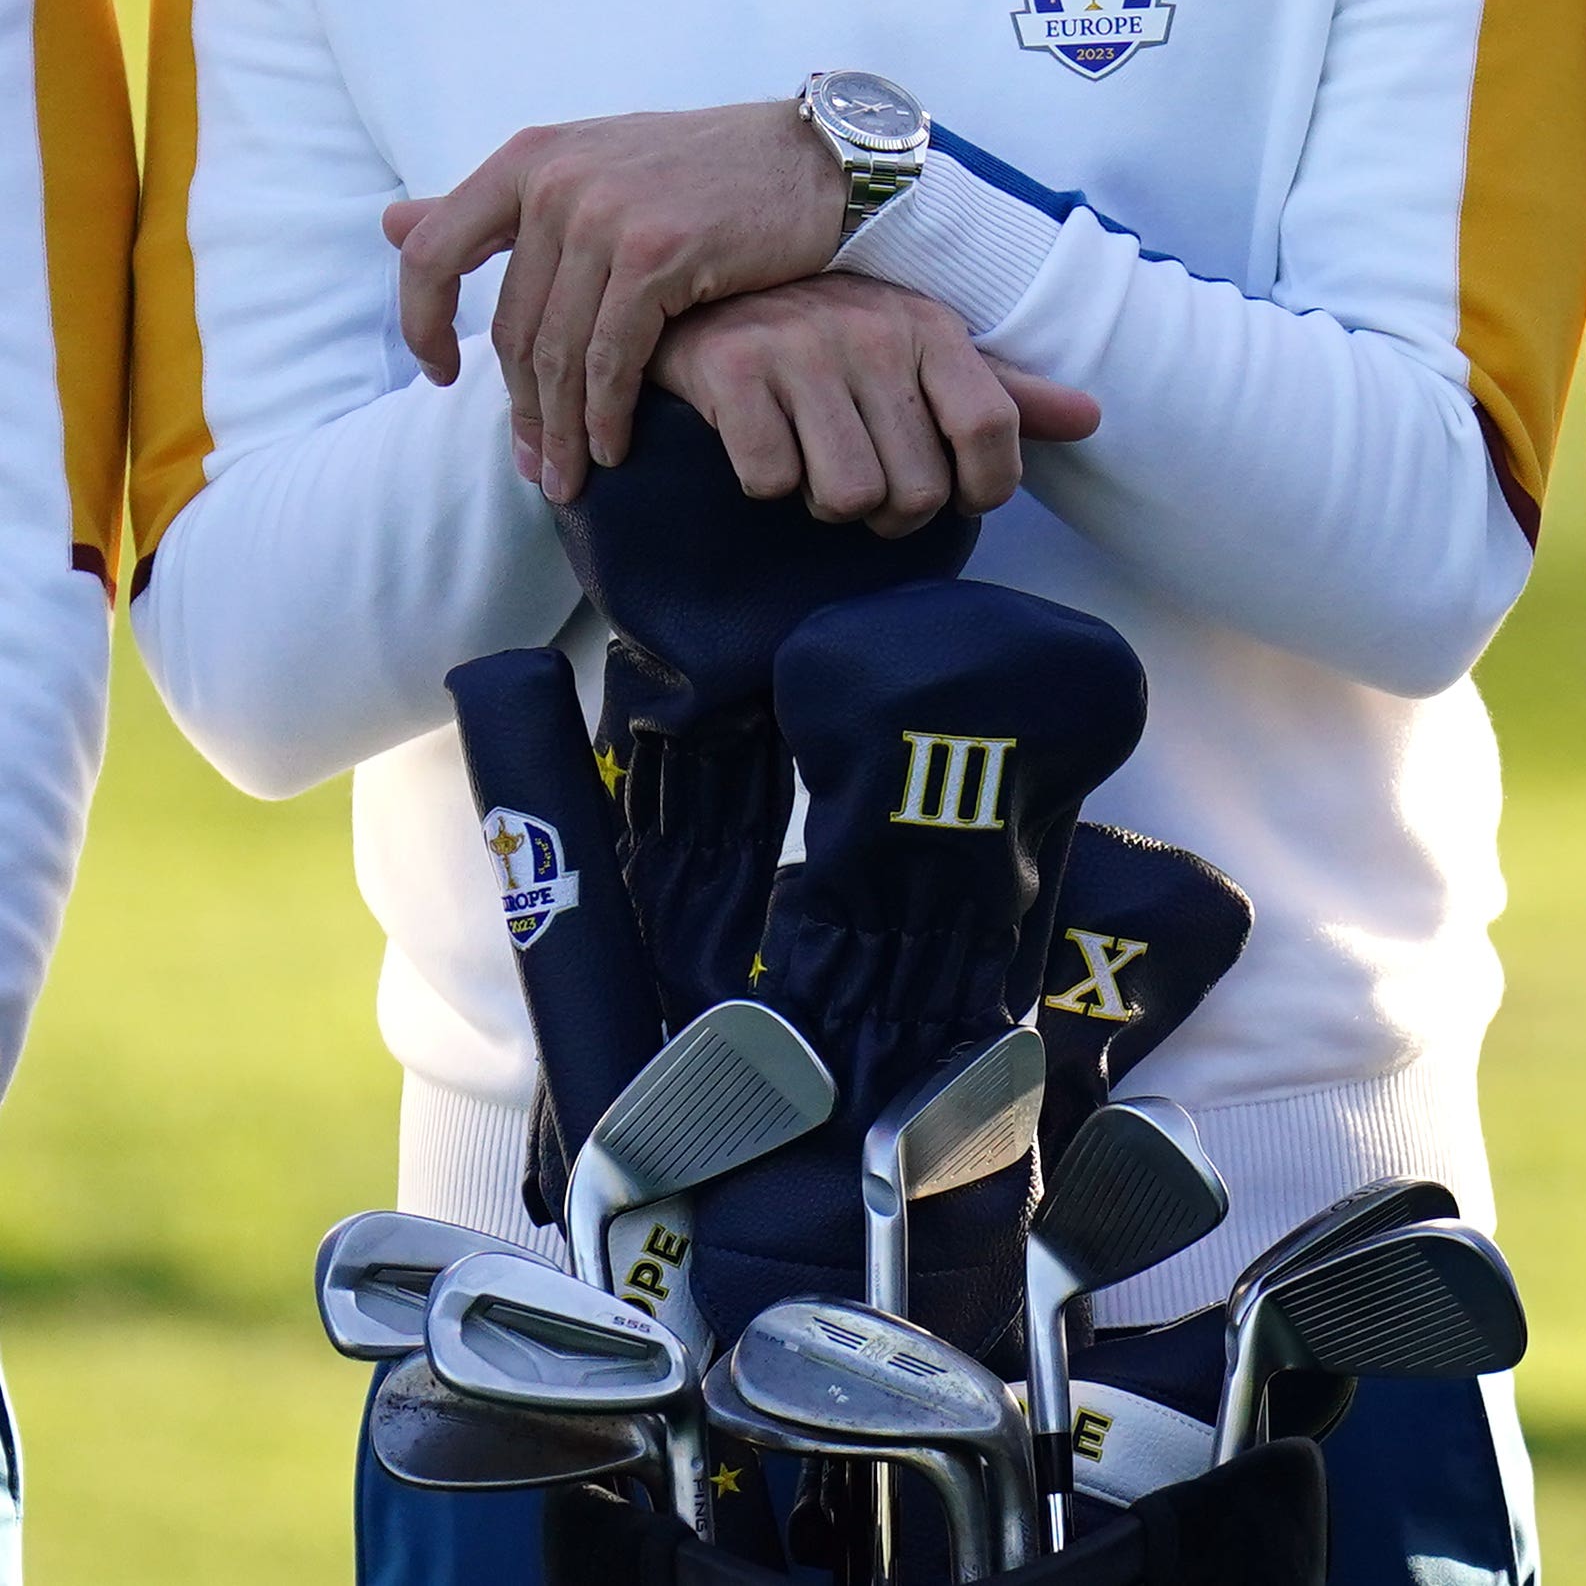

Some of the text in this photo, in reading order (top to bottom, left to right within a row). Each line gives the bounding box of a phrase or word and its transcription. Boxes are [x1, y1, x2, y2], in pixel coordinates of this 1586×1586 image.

[1046, 16, 1143, 38] EUROPE
[1076, 48, 1115, 60] 2023
[890, 730, 1017, 830] III
[1044, 927, 1149, 1022] X
[692, 1478, 707, 1533] PING
